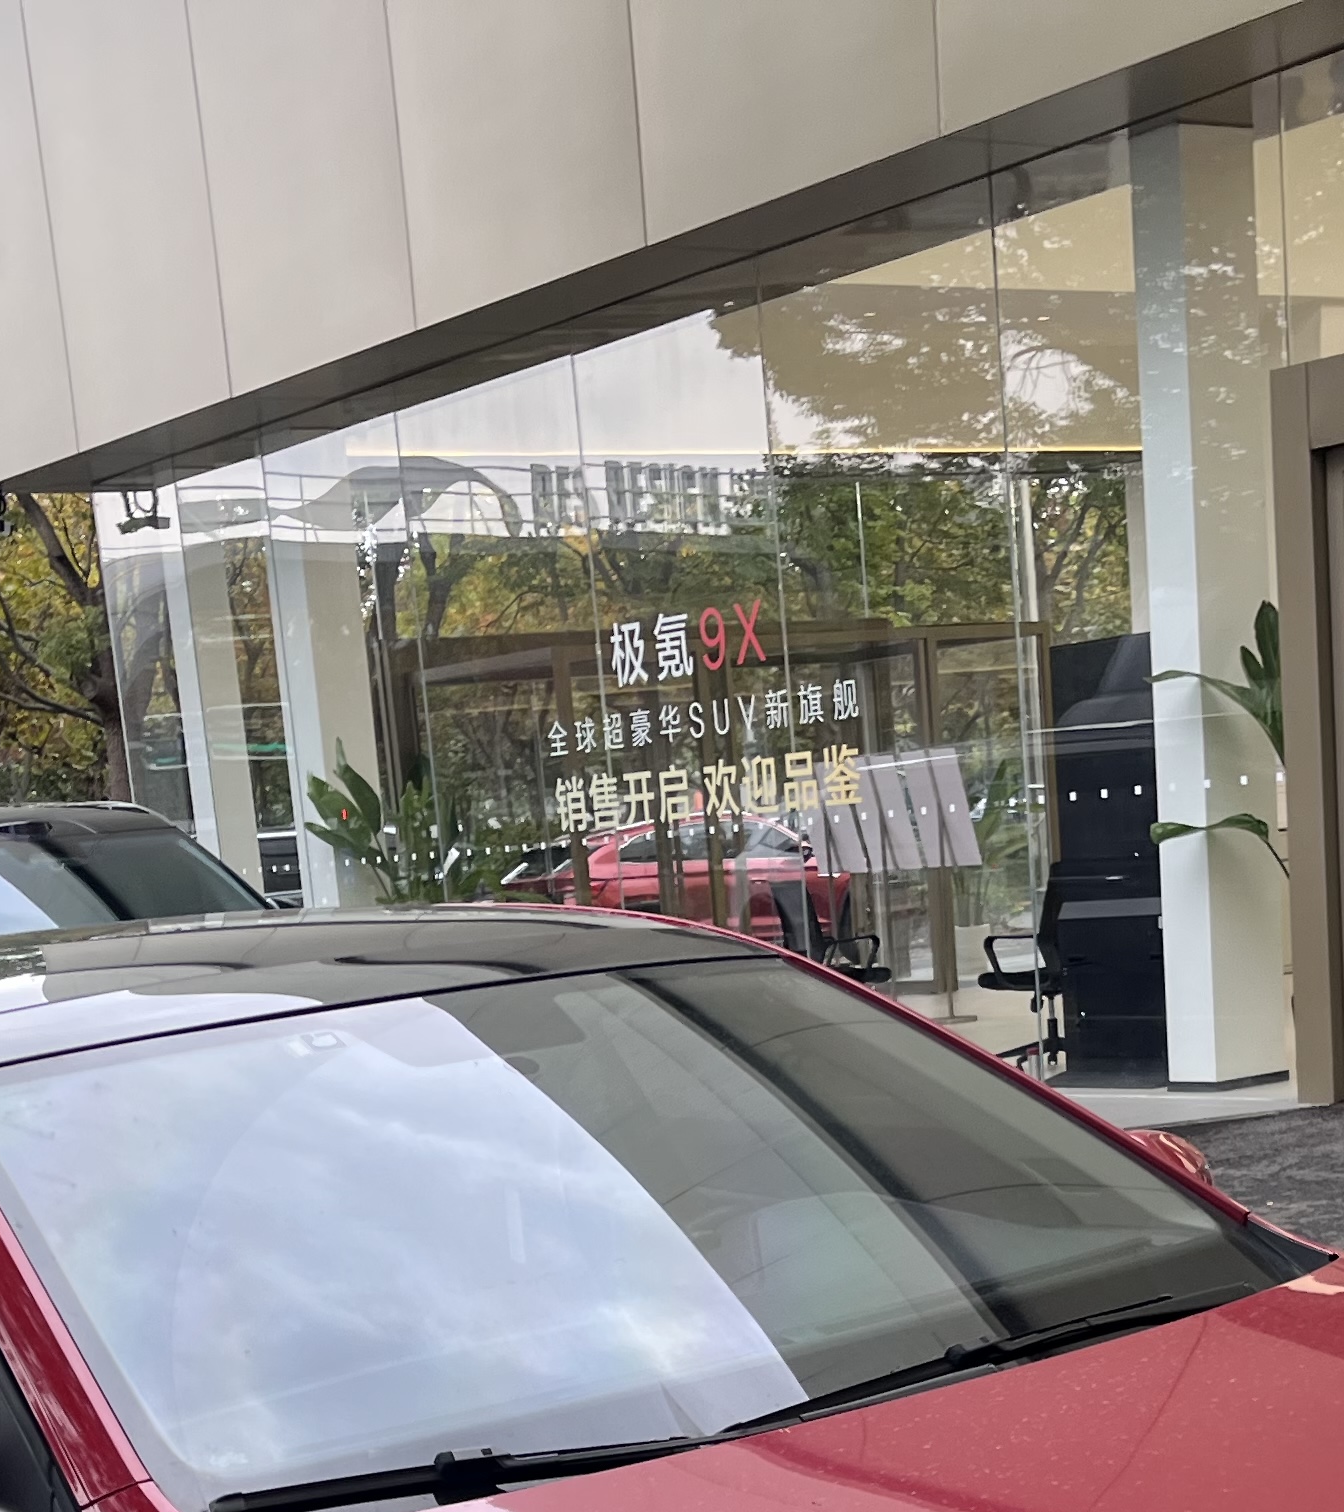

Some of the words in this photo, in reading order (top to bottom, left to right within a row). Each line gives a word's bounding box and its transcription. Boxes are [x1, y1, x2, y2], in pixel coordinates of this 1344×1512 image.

[610, 599, 766, 688] 极氪9X
[547, 678, 859, 757] 全球超豪华SUV新旗舰
[555, 763, 690, 832] 销售开启
[702, 743, 862, 818] 欢迎品鉴
